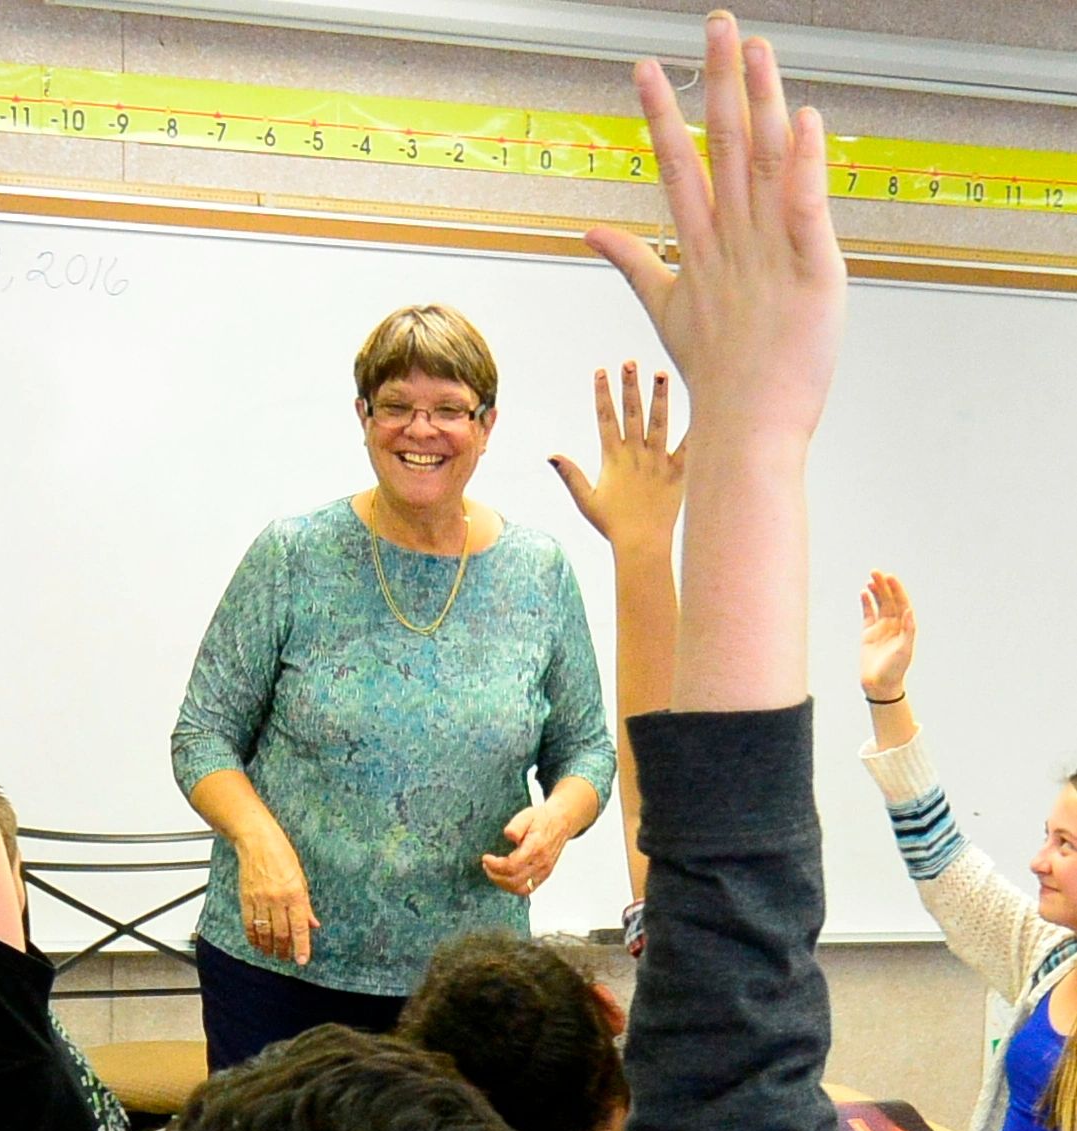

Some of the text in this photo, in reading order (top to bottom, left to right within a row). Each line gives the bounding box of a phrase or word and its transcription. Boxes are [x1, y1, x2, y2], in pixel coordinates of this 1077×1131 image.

[0, 105, 30, 127] -11
[51, 109, 85, 131] -10
[109, 113, 129, 134] -9
[158, 118, 178, 138] -8
[207, 123, 226, 142] -7
[256, 127, 276, 147] -6
[304, 131, 324, 150] -5
[352, 135, 371, 155] -4
[399, 139, 418, 159] -3
[445, 143, 464, 162] -2
[492, 147, 507, 166] -1
[540, 150, 552, 169] 0
[587, 153, 594, 172] 1
[630, 157, 642, 176] 2
[847, 173, 858, 192] 7
[887, 176, 899, 195] 8
[929, 180, 940, 198] 9
[965, 182, 984, 202] 10
[1006, 186, 1022, 206] 11
[1044, 188, 1064, 208] 12
[25, 250, 130, 296] 2016
